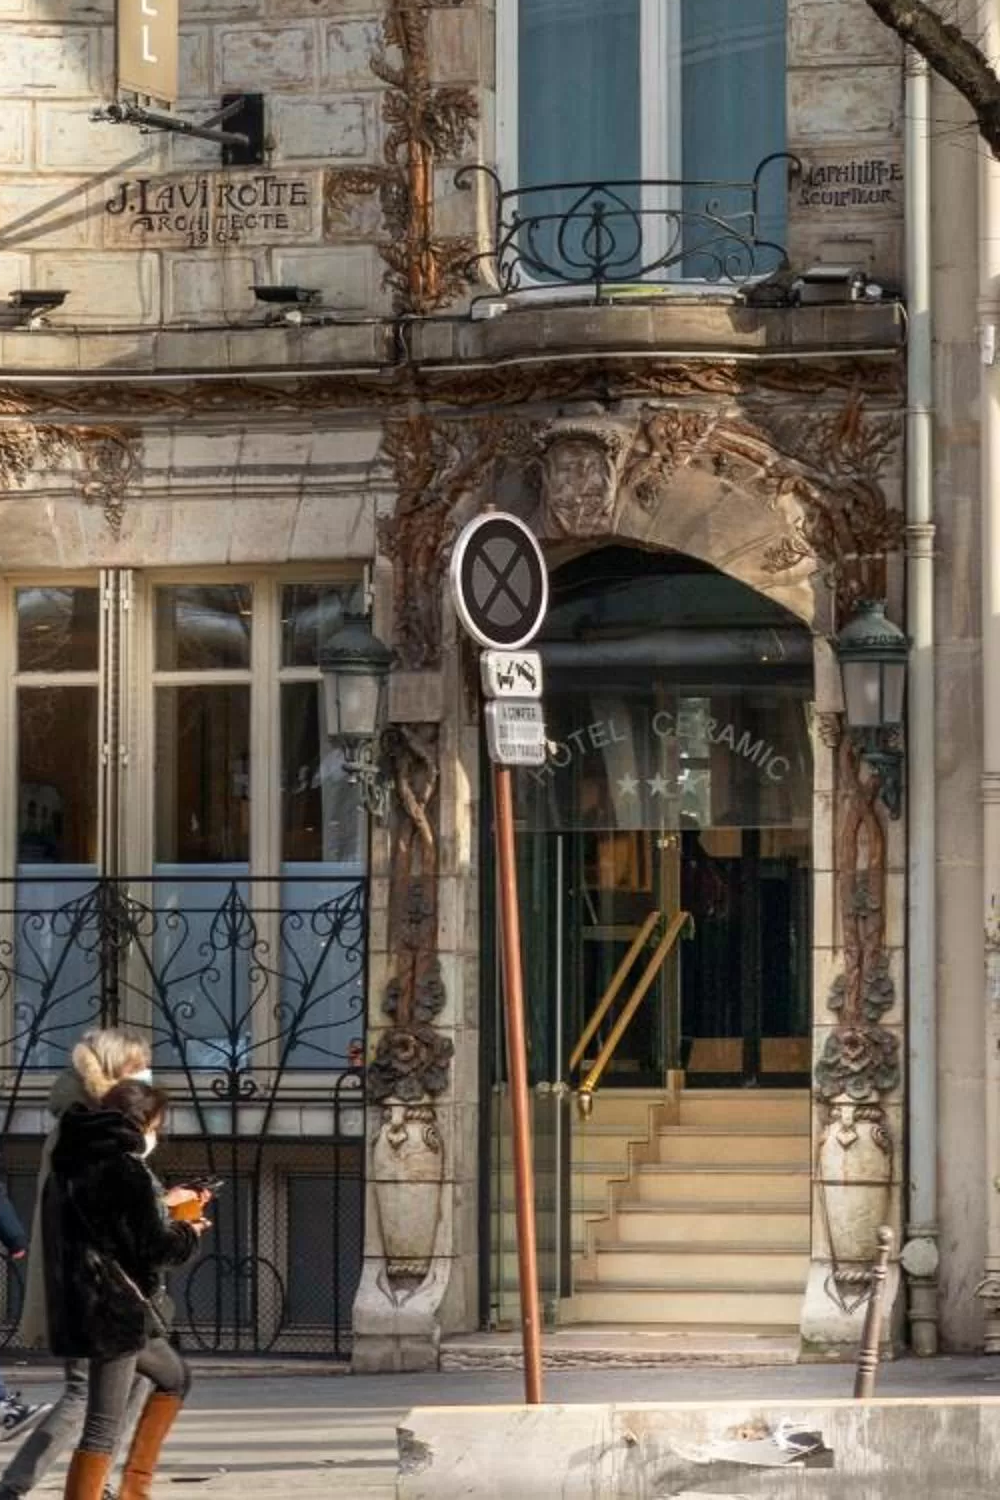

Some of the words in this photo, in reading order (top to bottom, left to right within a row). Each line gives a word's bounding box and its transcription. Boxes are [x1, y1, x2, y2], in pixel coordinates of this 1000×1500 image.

[130, 212, 290, 233] ARCHITECTE
[527, 719, 627, 787] HOTEL
[652, 710, 791, 781] CERAMIC
